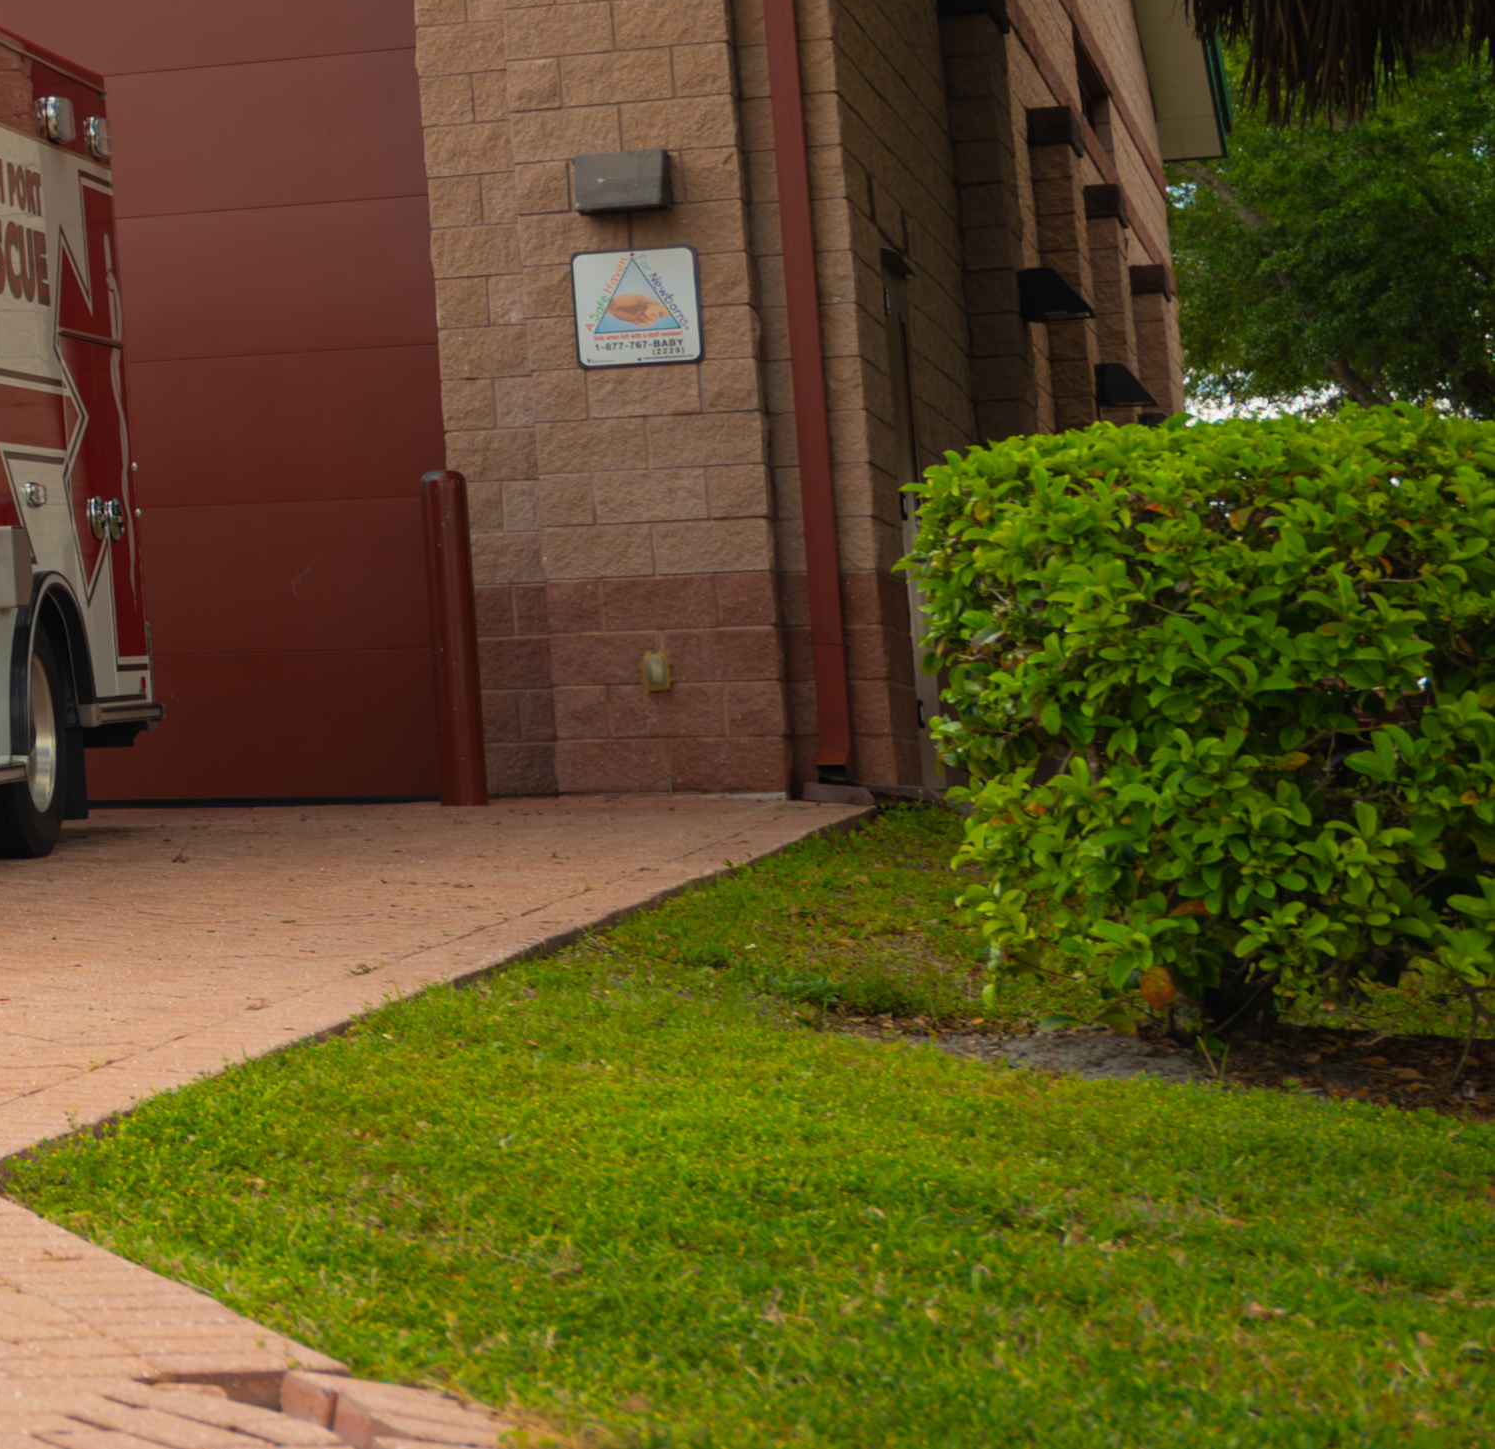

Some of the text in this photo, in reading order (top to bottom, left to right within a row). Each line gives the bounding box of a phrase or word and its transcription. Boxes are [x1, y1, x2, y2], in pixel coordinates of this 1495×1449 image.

[7, 161, 42, 217] PORT
[636, 253, 652, 272] For
[585, 257, 628, 332] A Safe Haven
[595, 338, 684, 351] 1-877-767-BABY
[652, 346, 685, 355] (2229)
